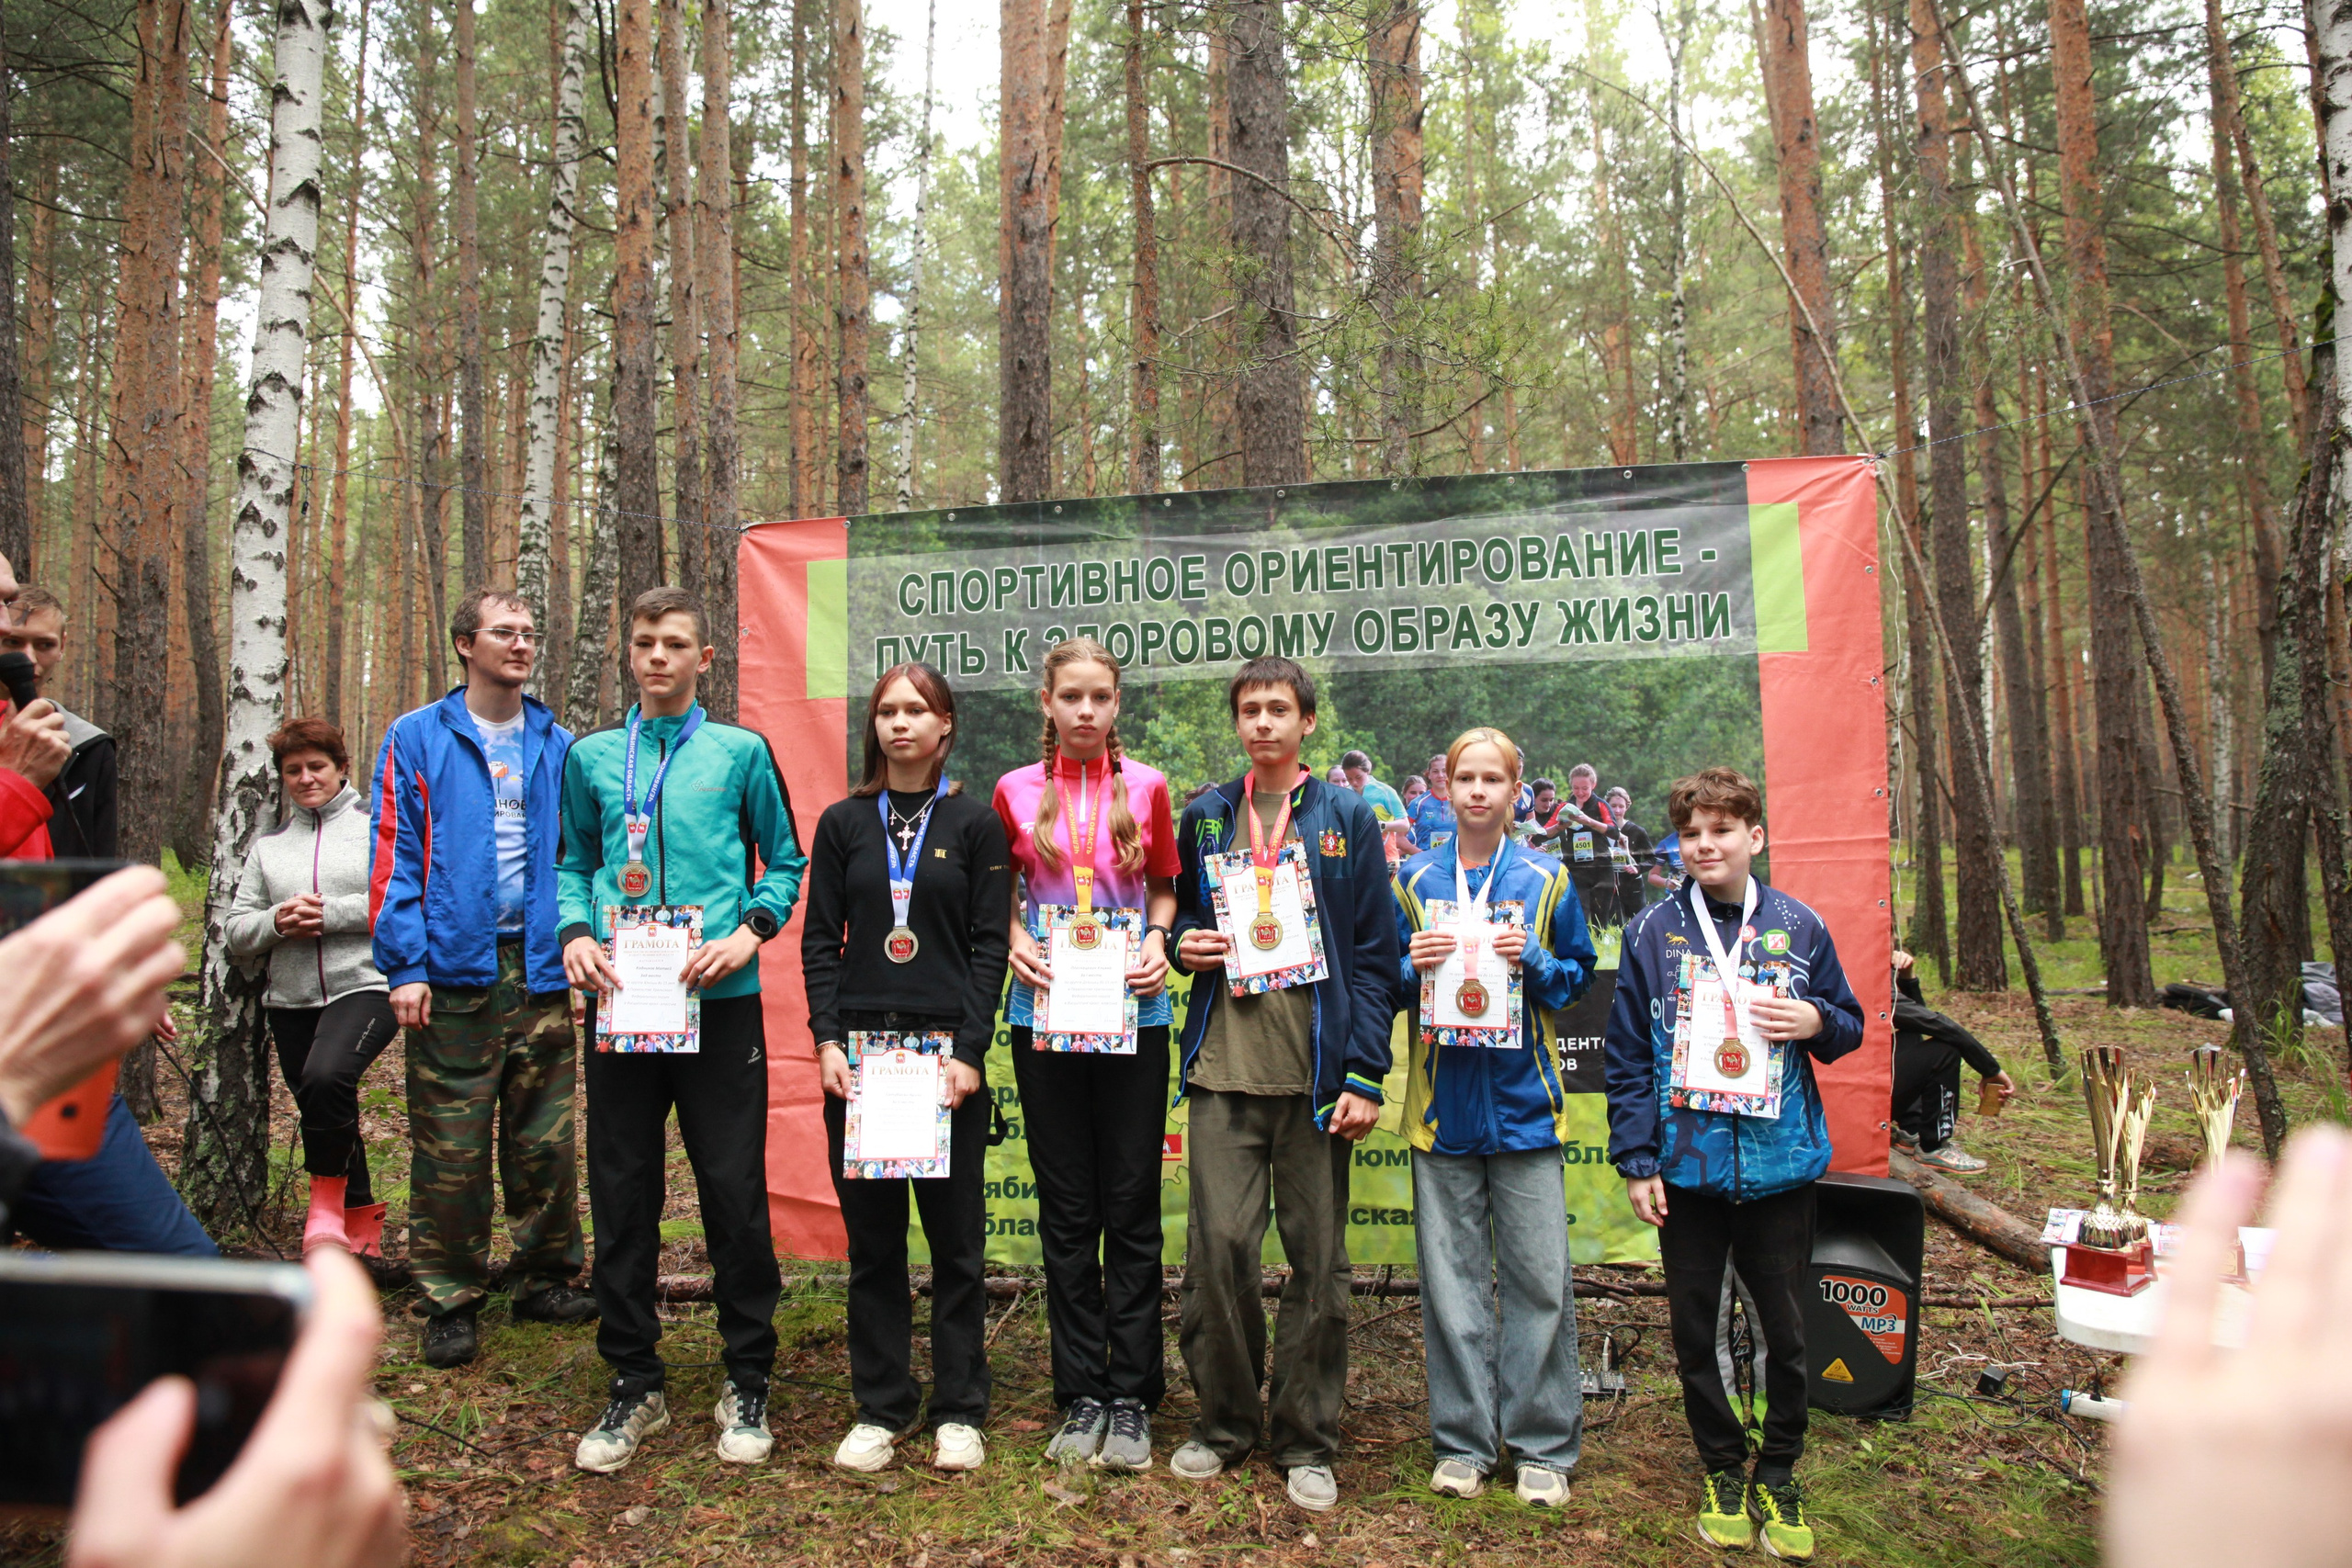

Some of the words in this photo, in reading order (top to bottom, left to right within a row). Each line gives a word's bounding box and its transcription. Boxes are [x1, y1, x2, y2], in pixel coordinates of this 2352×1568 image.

[898, 555, 1207, 618] СПОРТИВНОЕ
[1224, 528, 1682, 599] ОРИЕНТИРОВАНИЕ
[875, 631, 988, 681] ПУТЬ
[1003, 628, 1029, 673] К
[1352, 600, 1541, 656] ОБРАЗУ
[1556, 592, 1731, 648] ЖИЗНИ
[627, 721, 639, 770] ЧЕЛЯБИНСКАЯ
[626, 770, 634, 802] ОБЛАСТЬ
[648, 754, 672, 803] ЧЕЛЯБИНСКА
[1066, 802, 1080, 854] ЧЕЛЯБИНСКАЯ
[1086, 821, 1096, 854] ОБЛАСТЬ
[1251, 808, 1261, 855] ЧЕЛЯБИНСК
[1269, 824, 1283, 857] ОБЛАСТЬ
[909, 835, 922, 868] ОБЛАСТЬ
[623, 939, 680, 950] ГРАМОТА
[1666, 949, 1692, 959] DINA
[870, 1066, 930, 1076] ГРАМОТА
[1819, 1280, 1888, 1306] 1000
[1847, 1304, 1880, 1314] WATTS
[1860, 1316, 1896, 1332] MP3
